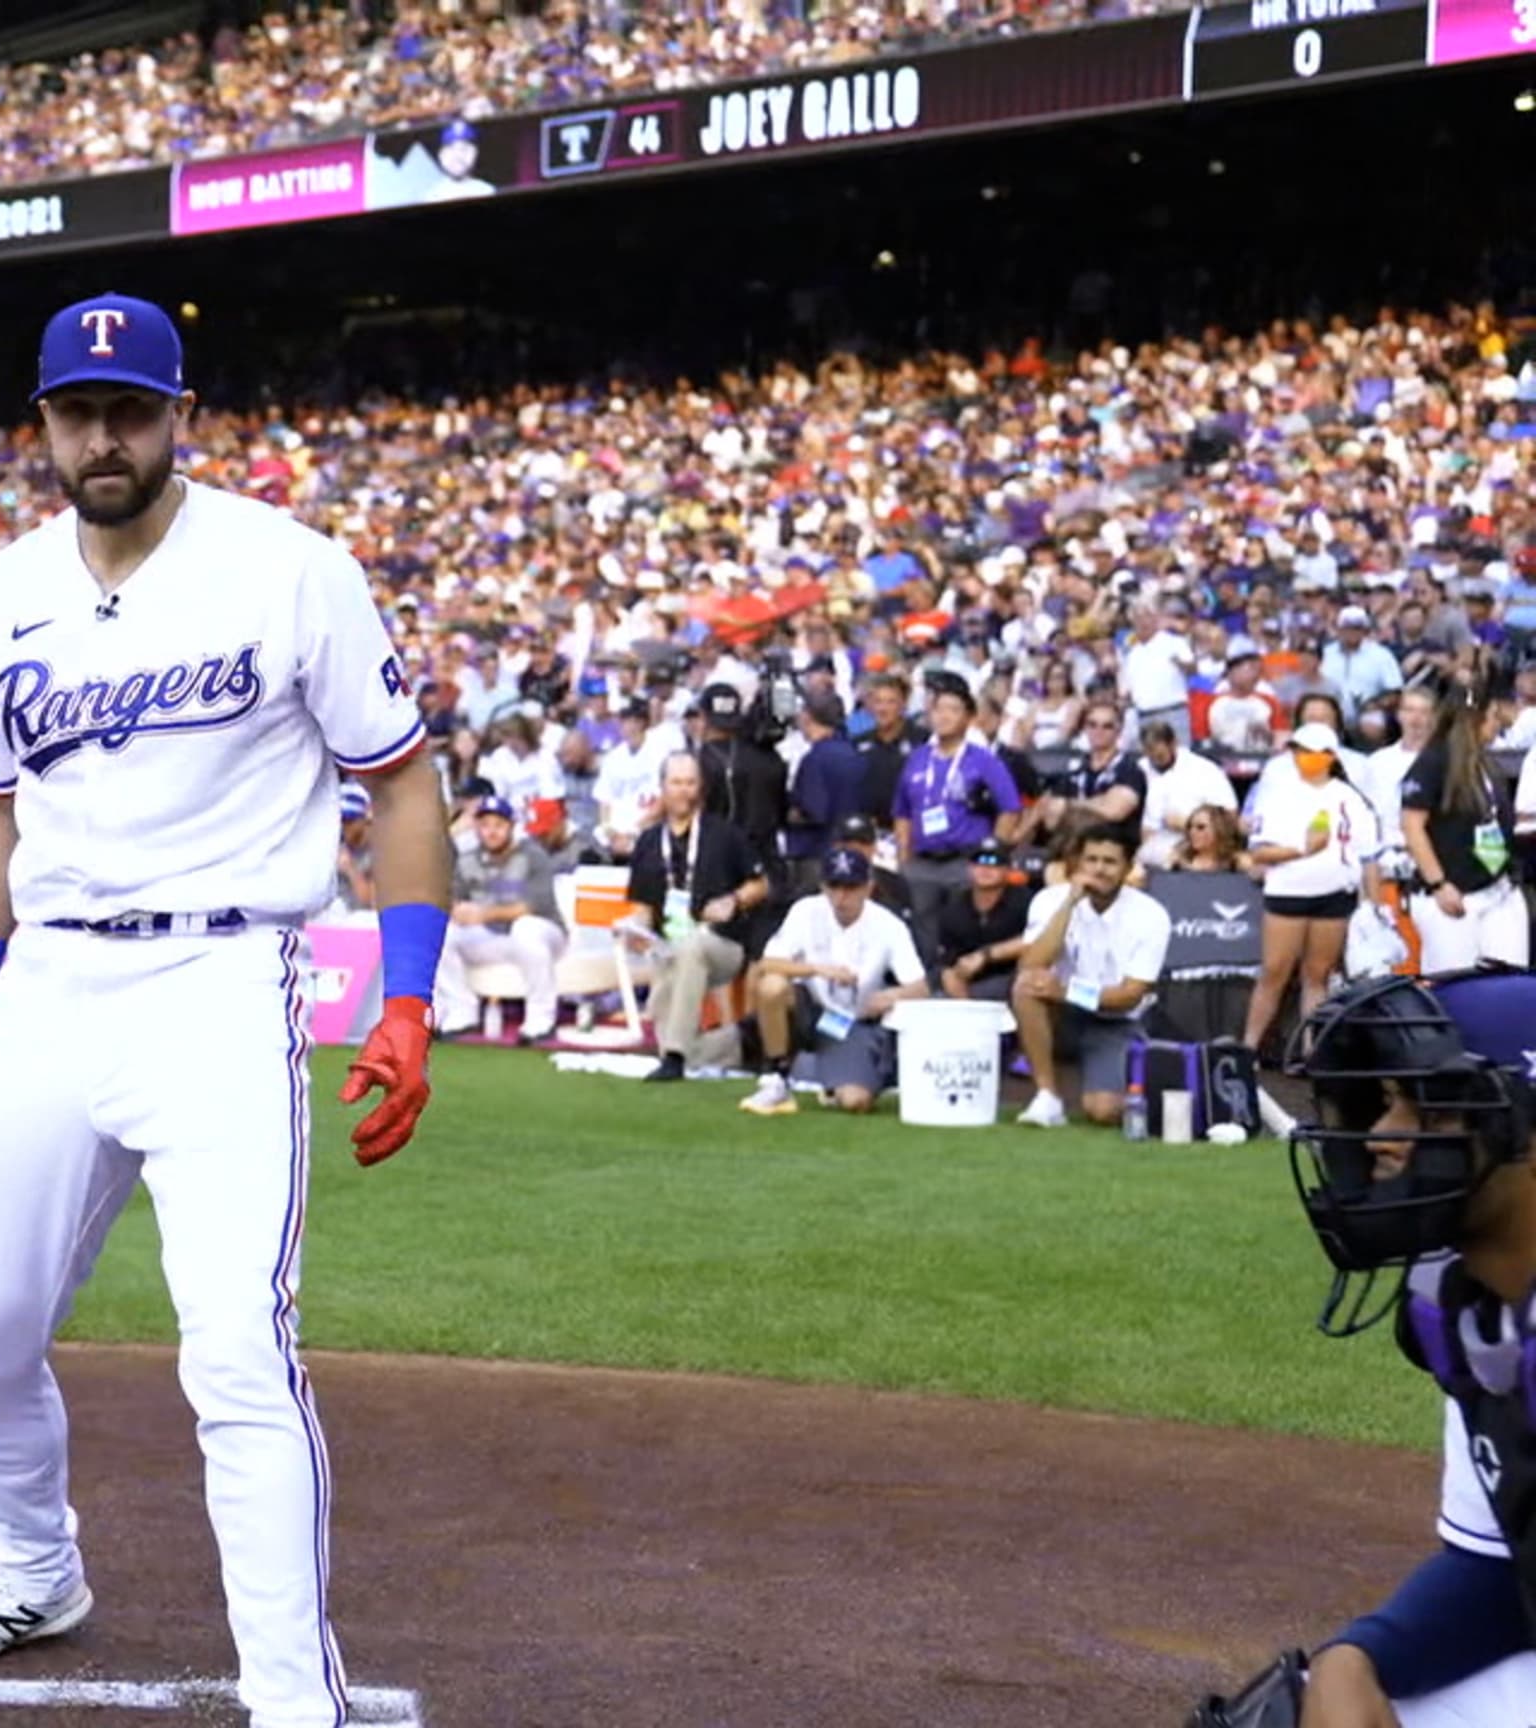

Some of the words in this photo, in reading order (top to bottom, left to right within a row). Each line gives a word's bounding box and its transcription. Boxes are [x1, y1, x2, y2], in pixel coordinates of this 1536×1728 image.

[1293, 29, 1322, 77] 0
[628, 115, 661, 154] 44
[700, 84, 793, 155] JOEY
[801, 66, 920, 141] GALLO
[189, 176, 244, 211] NOW
[249, 162, 353, 204] BATTING
[81, 309, 126, 357] T
